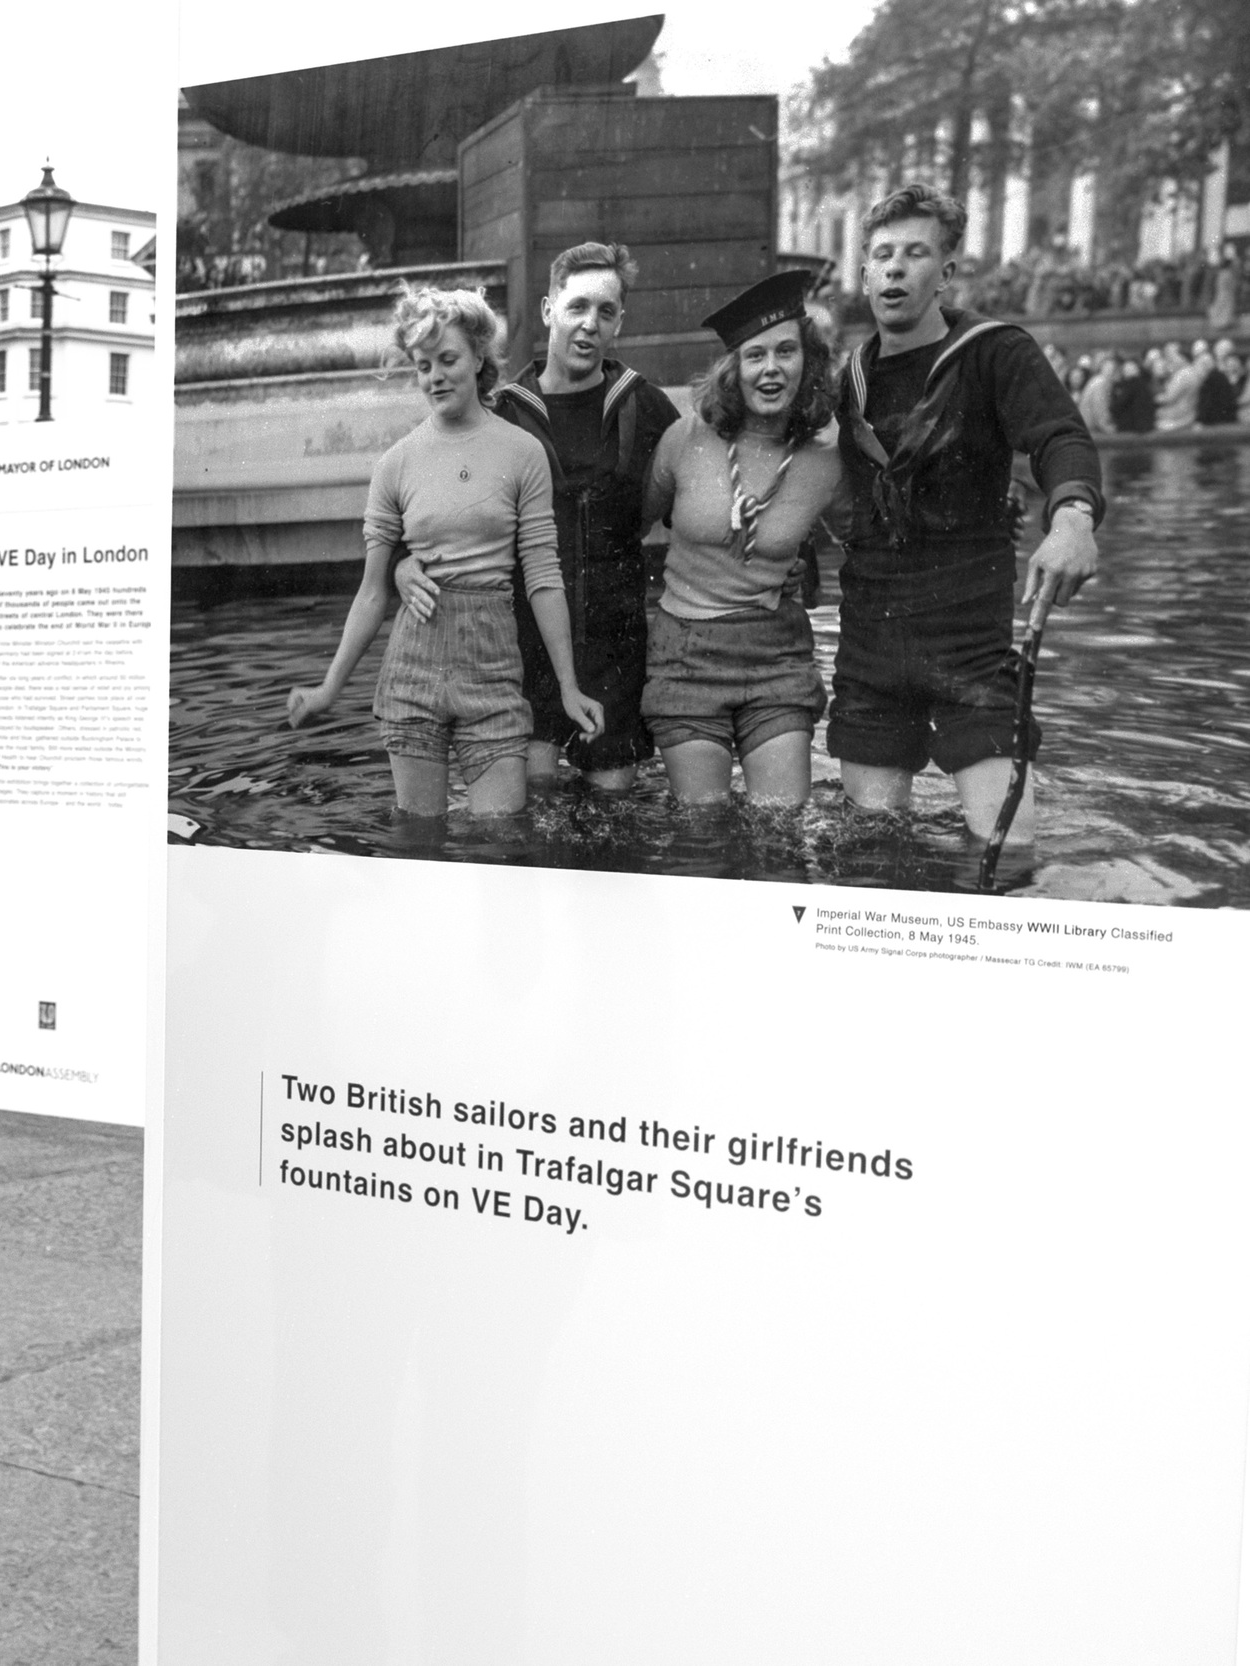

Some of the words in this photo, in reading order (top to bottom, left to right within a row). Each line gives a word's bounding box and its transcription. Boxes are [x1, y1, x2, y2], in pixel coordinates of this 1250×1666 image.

[39, 459, 55, 473] OF
[57, 456, 111, 472] LONDON
[24, 548, 57, 570] Day
[61, 547, 77, 565] in
[82, 544, 149, 564] London
[815, 923, 842, 936] Print
[844, 925, 905, 941] Collection,
[908, 930, 916, 941] 8
[919, 930, 944, 945] May
[948, 933, 980, 946] 1945.
[816, 907, 861, 921] Imperial
[864, 910, 887, 922] War
[890, 912, 943, 927] Museum,
[947, 916, 965, 928] US
[968, 917, 1024, 934] Embassy
[1026, 921, 1060, 935] WWII
[1063, 924, 1107, 940] Library
[1110, 927, 1173, 943] Classified
[815, 941, 836, 952] Photo
[837, 944, 846, 953] by
[848, 944, 859, 953] US
[860, 945, 879, 956] Army
[881, 946, 903, 957] Signal
[905, 948, 927, 959] Corps
[929, 951, 978, 962] photographer
[1024, 957, 1035, 967] TG
[1066, 961, 1083, 970] IWM
[1085, 962, 1100, 972] (EA
[281, 1073, 336, 1106] Two
[347, 1082, 442, 1120] British
[453, 1099, 557, 1134] sailors
[568, 1116, 627, 1144] and
[638, 1120, 716, 1154] their
[727, 1132, 914, 1181] girlfriends
[280, 1120, 377, 1156] splash
[382, 1132, 467, 1168] about
[477, 1143, 504, 1173] in
[515, 1148, 659, 1196] Trafalgar
[670, 1169, 822, 1217] Square’s
[279, 1158, 413, 1203] fountains
[423, 1186, 459, 1211] on
[471, 1186, 511, 1219] VE
[523, 1194, 588, 1235] Day.
